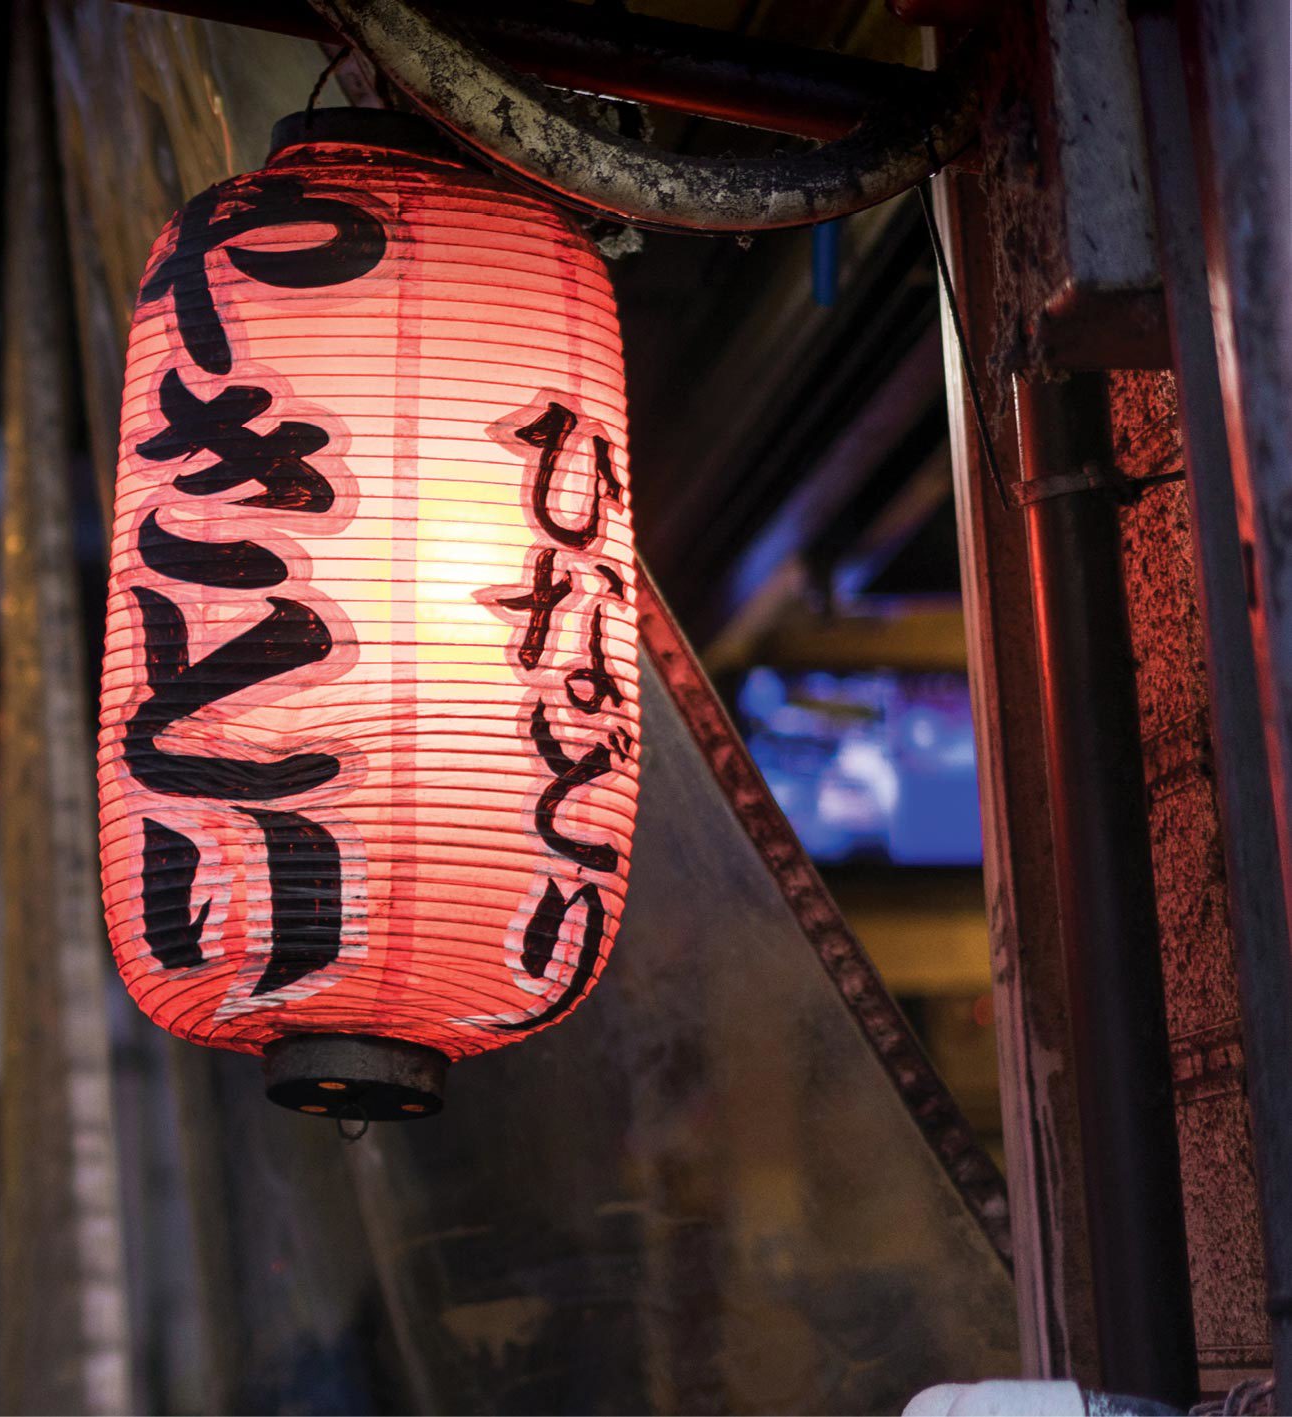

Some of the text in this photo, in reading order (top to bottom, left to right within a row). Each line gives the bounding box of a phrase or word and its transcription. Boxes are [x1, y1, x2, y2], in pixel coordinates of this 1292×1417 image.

[123, 180, 387, 997] やきとり
[491, 402, 631, 1031] ひなどり
